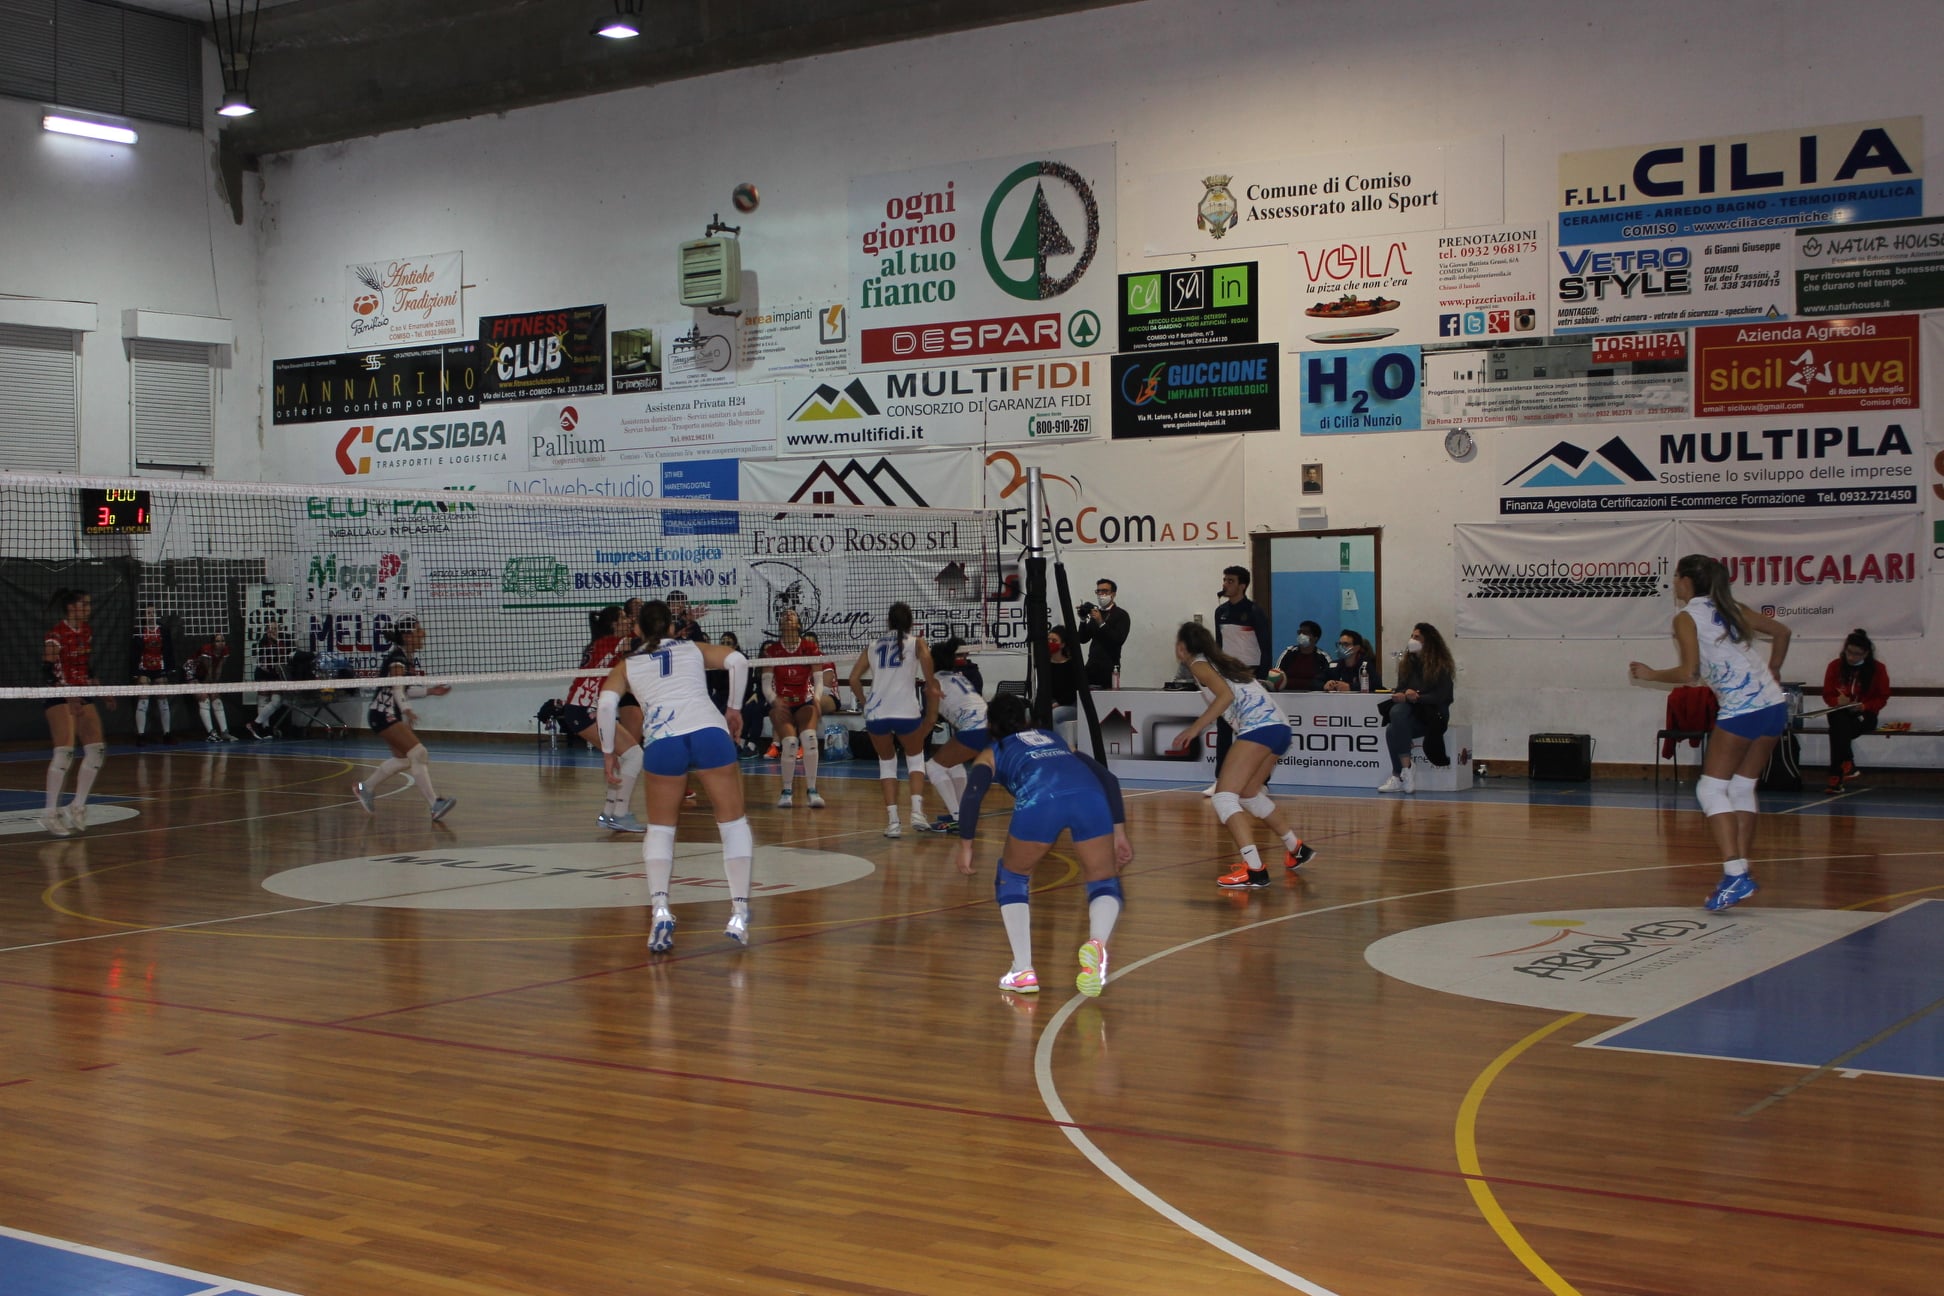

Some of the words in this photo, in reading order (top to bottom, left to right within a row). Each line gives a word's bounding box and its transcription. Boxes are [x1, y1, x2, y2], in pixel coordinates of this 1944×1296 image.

[1633, 128, 1913, 197] CILIA
[1246, 181, 1318, 201] Comune
[1323, 177, 1339, 194] di
[1345, 172, 1412, 192] Comiso
[1565, 185, 1625, 206] F.LLI
[887, 181, 956, 223] ogni
[1246, 199, 1345, 222] Assessorato
[1351, 195, 1383, 212] allo
[1388, 190, 1439, 213] Sport
[1563, 210, 1643, 227] CERAMICHE
[1655, 204, 1712, 219] ARREDO
[1716, 201, 1767, 214] BAGNO
[1779, 186, 1915, 208] TERMOIDRAULICA
[862, 221, 956, 256] giorno
[1438, 230, 1537, 248] PRENOTAZIONI
[1622, 223, 1677, 237] COMISO
[1439, 248, 1457, 259] tel.
[1460, 246, 1490, 258] 0932
[1493, 241, 1537, 254] 968175
[1704, 246, 1712, 256] di
[1714, 244, 1740, 254] Gianni
[1742, 242, 1781, 253] Giuseppe
[1826, 237, 1889, 256] NATUR
[881, 250, 906, 278] al
[910, 252, 956, 274] tuo
[1558, 247, 1691, 275] VETRO
[1704, 264, 1739, 275] COMISO
[383, 262, 434, 288] Antiche
[1704, 274, 1718, 283] Via
[1719, 272, 1733, 281] dei
[1734, 271, 1771, 282] Frassini,
[1773, 270, 1779, 278] 3
[1803, 273, 1819, 281] Per
[1821, 271, 1861, 280] ritrovare
[1863, 268, 1890, 278] forma
[1895, 265, 1944, 275] benessere
[860, 276, 956, 309] fianco
[1221, 276, 1241, 299] in
[1306, 284, 1315, 293] la
[1317, 282, 1341, 294] pizza
[1343, 280, 1361, 291] che
[1362, 281, 1381, 289] non
[1559, 270, 1691, 301] STYLE
[1704, 282, 1719, 291] Tel.
[1721, 281, 1738, 290] 338
[1740, 278, 1780, 289] 3410415
[1803, 283, 1820, 292] che
[1821, 281, 1855, 291] durano
[1857, 280, 1872, 289] nel
[1873, 279, 1907, 289] tempo.
[392, 287, 458, 319] Tradizioni
[1439, 291, 1536, 308] www.pizzeriavoila.it
[1803, 300, 1890, 313] www.naturhouse.it
[745, 308, 813, 325] areaimpianti
[1558, 306, 1599, 317] MONTAGGIO:
[1558, 317, 1574, 326] vetri
[1573, 315, 1600, 326] sabbiati
[1605, 313, 1622, 323] vetri
[1622, 313, 1648, 322] camera
[1653, 311, 1678, 320] vetrate
[1679, 309, 1686, 318] di
[1687, 308, 1719, 318] sicurezza
[1725, 306, 1763, 318] specchiere
[492, 313, 569, 339] FITNESS
[1736, 325, 1801, 342] Azienda
[1806, 323, 1876, 341] Agricola
[892, 319, 1059, 355] DESPAR
[1594, 333, 1684, 352] TOSHIBA
[497, 335, 562, 381] CLUB
[1596, 349, 1680, 359] PARTNER
[887, 361, 1090, 399] MULTIFIDI
[1167, 358, 1268, 387] GUCCIONE
[1710, 358, 1782, 392] sicil
[1837, 358, 1904, 385] uva
[529, 387, 552, 396] COMISO
[1168, 387, 1209, 400] IMPIANTI
[1212, 384, 1269, 397] TECNOLOGICI
[1828, 388, 1837, 396] di
[1838, 386, 1867, 395] Rosario
[1868, 385, 1904, 394] Battaglia
[276, 406, 332, 418] osteria
[344, 394, 475, 413] contemporanea
[645, 402, 690, 413] Assistenza
[693, 400, 726, 410] Privata
[728, 396, 746, 407] H24
[887, 401, 962, 417] CONSORZIO
[968, 400, 984, 413] DI
[988, 398, 1056, 412] GARANZIA
[1061, 395, 1091, 407] FIDI
[1703, 404, 1727, 413] email:
[1727, 402, 1804, 412] siciluva@gmail.com
[1860, 398, 1891, 407] Comiso
[1892, 397, 1912, 406] (RG)
[1036, 418, 1089, 434] 800-910-267
[1320, 417, 1330, 429] di
[1333, 415, 1360, 429] Cilia
[1364, 413, 1402, 427] Nunzio
[375, 420, 507, 453] CASSIBBA
[532, 434, 606, 458] Pallium
[787, 425, 924, 446] www.multifidi.it
[1660, 424, 1912, 464] MULTIPLA
[377, 457, 432, 469] TRASPORTI
[449, 453, 507, 464] LOGISTICA
[1660, 471, 1721, 484] Sostiene
[1726, 470, 1738, 482] lo
[1743, 468, 1805, 483] sviluppo
[1809, 466, 1845, 480] delle
[1851, 465, 1912, 479] imprese
[1506, 499, 1544, 511] Finanza
[1547, 498, 1597, 511] Agevolata
[1600, 496, 1667, 508] Certificazioni
[1671, 495, 1738, 507] E-commerce
[1741, 493, 1806, 505] Formazione
[1817, 492, 1837, 502] Tel.
[1840, 490, 1912, 501] 0932.721450
[98, 507, 111, 526] 3
[752, 530, 835, 555] Franco
[845, 527, 916, 552] Rosso
[926, 522, 960, 550] srl
[1159, 521, 1239, 542] ADSL
[596, 548, 651, 566] Impresa
[655, 545, 723, 565] Ecologica
[575, 571, 622, 590] BUSSO
[624, 568, 714, 588] SEBASTIANO
[718, 568, 737, 585] srl
[1461, 556, 1669, 582] www.usatogomma.it
[1712, 552, 1916, 586] UTITICALARI
[1776, 606, 1834, 617] @putiticalari
[650, 649, 673, 678] 7
[875, 643, 904, 669] 12
